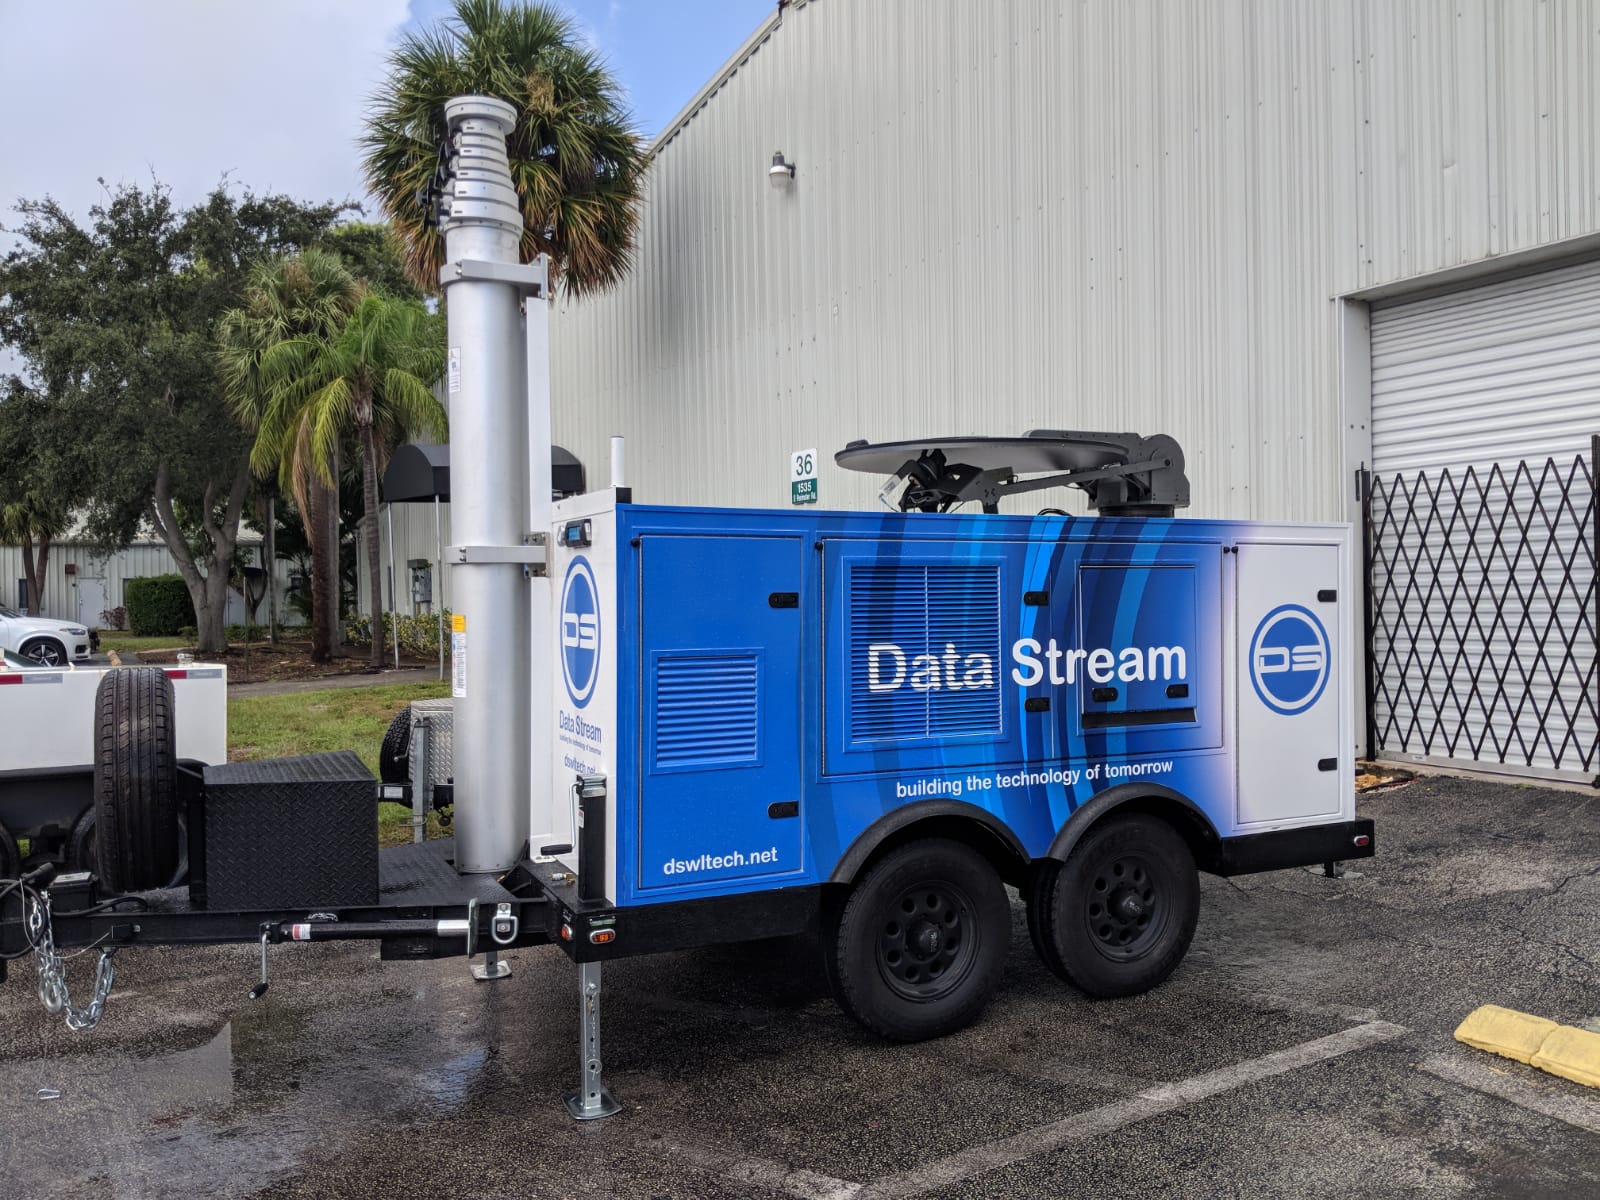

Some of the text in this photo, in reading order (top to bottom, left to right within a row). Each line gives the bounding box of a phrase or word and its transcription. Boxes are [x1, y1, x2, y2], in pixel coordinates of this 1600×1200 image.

[796, 453, 813, 476] 36
[798, 481, 811, 493] 1535
[563, 612, 597, 650] DS
[868, 638, 1187, 693] Data Stream
[1258, 644, 1323, 674] DS
[559, 709, 602, 744] Data Stream
[896, 760, 1174, 798] building the technology of tomorrow
[663, 846, 778, 875] dswltech.net
